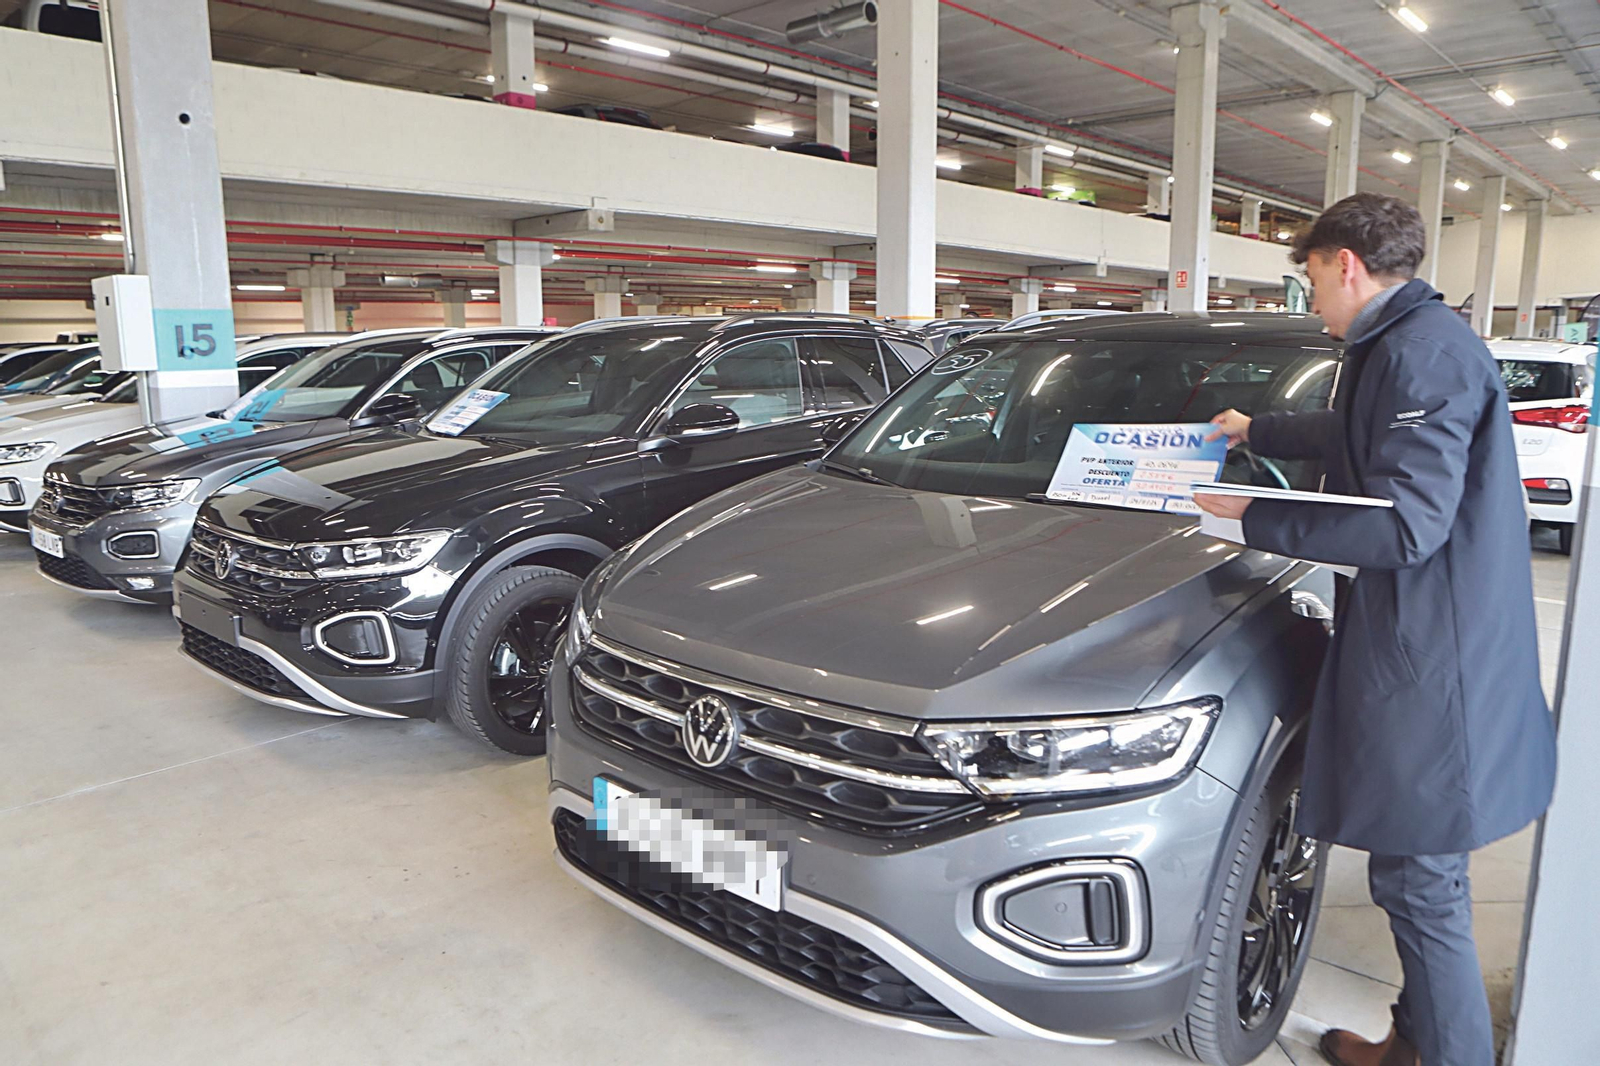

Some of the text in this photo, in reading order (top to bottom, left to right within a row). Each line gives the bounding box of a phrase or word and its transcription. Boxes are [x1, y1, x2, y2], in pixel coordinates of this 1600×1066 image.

[936, 354, 982, 370] 35
[1098, 458, 1135, 466] ANTERIOR
[1088, 468, 1130, 477] DESCUENTO
[1082, 477, 1126, 487] OFERTA
